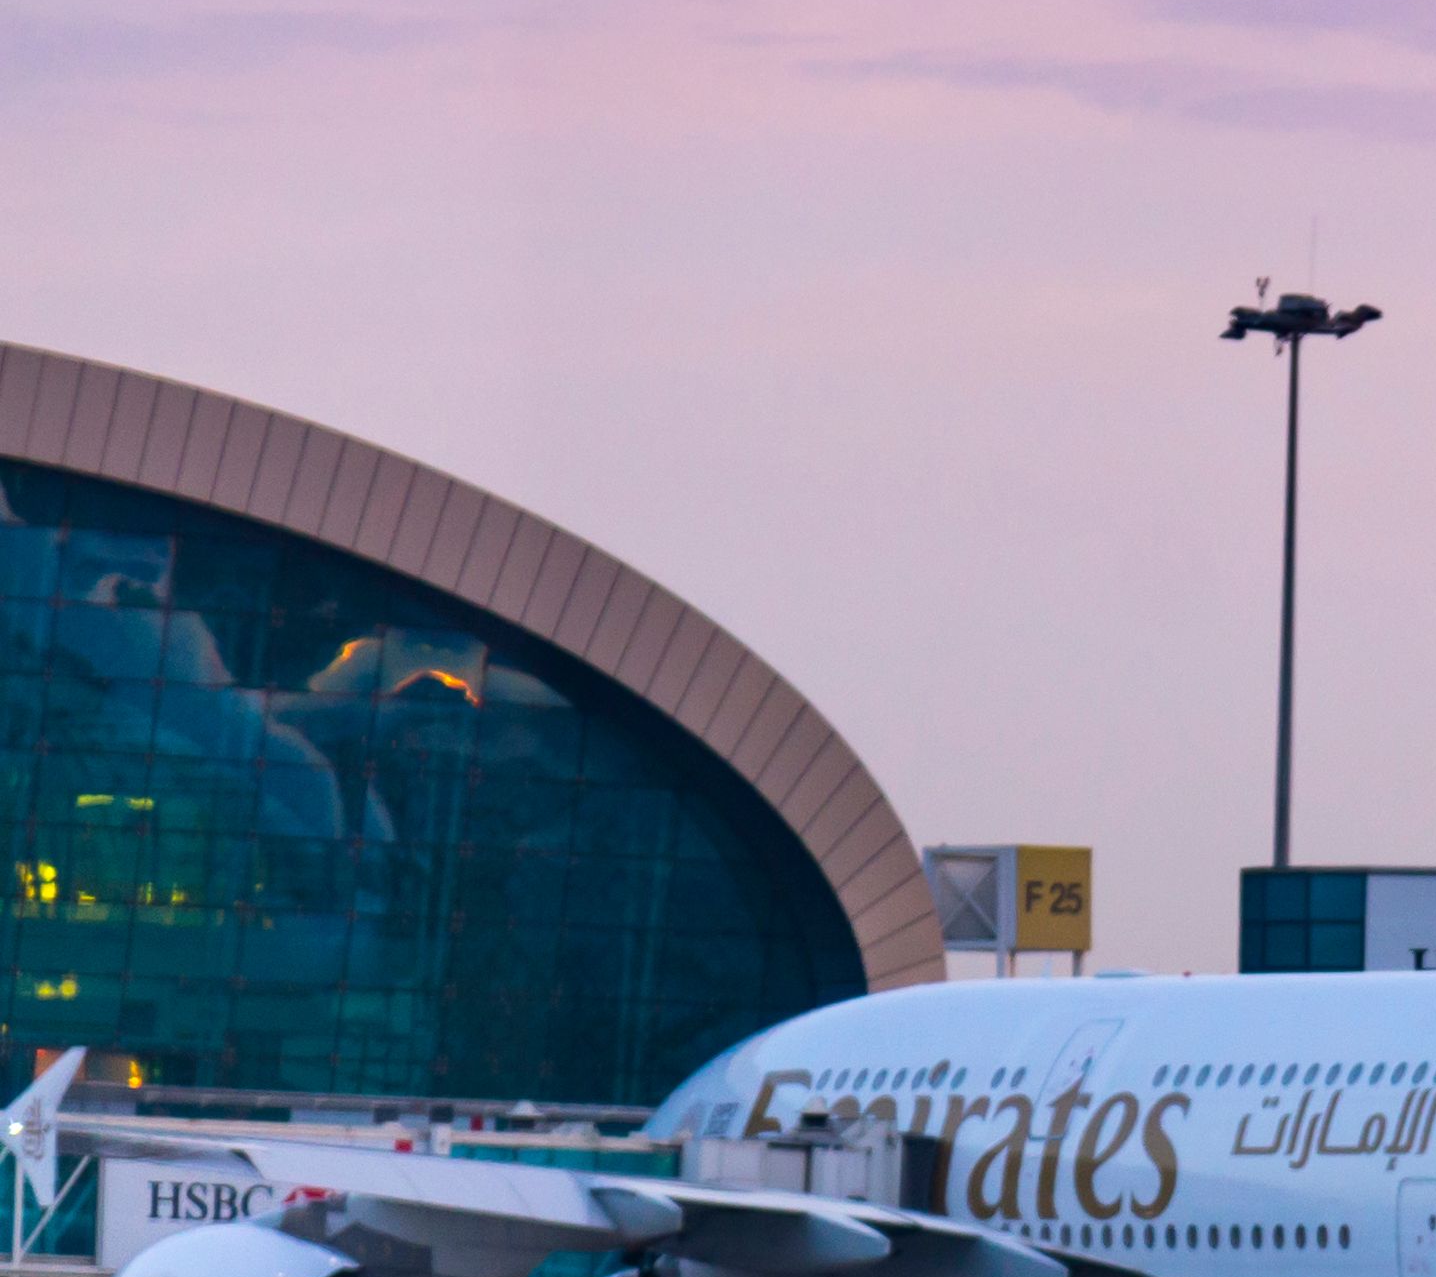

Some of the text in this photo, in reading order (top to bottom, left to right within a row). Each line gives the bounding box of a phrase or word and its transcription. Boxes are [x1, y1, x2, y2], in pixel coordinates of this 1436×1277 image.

[1026, 882, 1082, 914] F 25
[745, 1059, 1190, 1221] Eirates
[148, 1180, 274, 1221] HSBC
